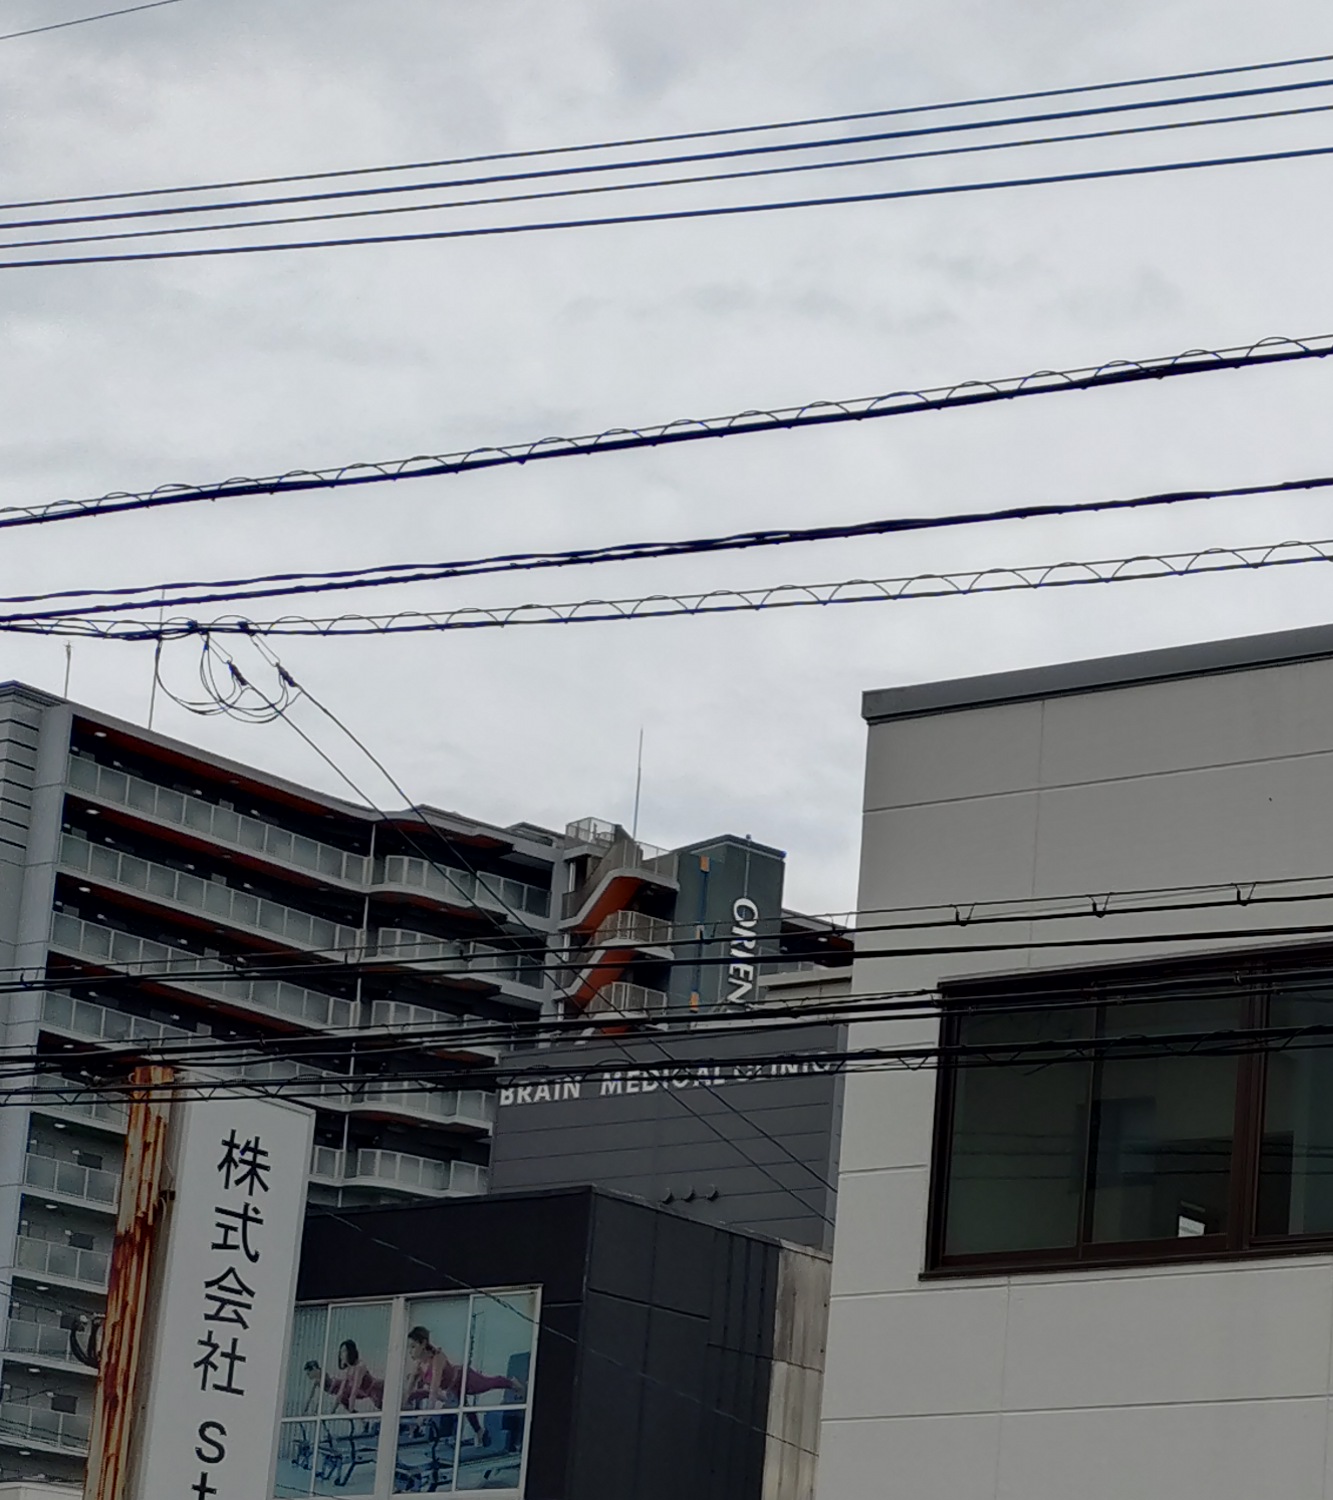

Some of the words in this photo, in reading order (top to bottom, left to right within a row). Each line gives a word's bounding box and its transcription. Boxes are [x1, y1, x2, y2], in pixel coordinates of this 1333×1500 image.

[499, 1077, 581, 1107] BRAIN
[192, 1129, 271, 1397] 株式会社
